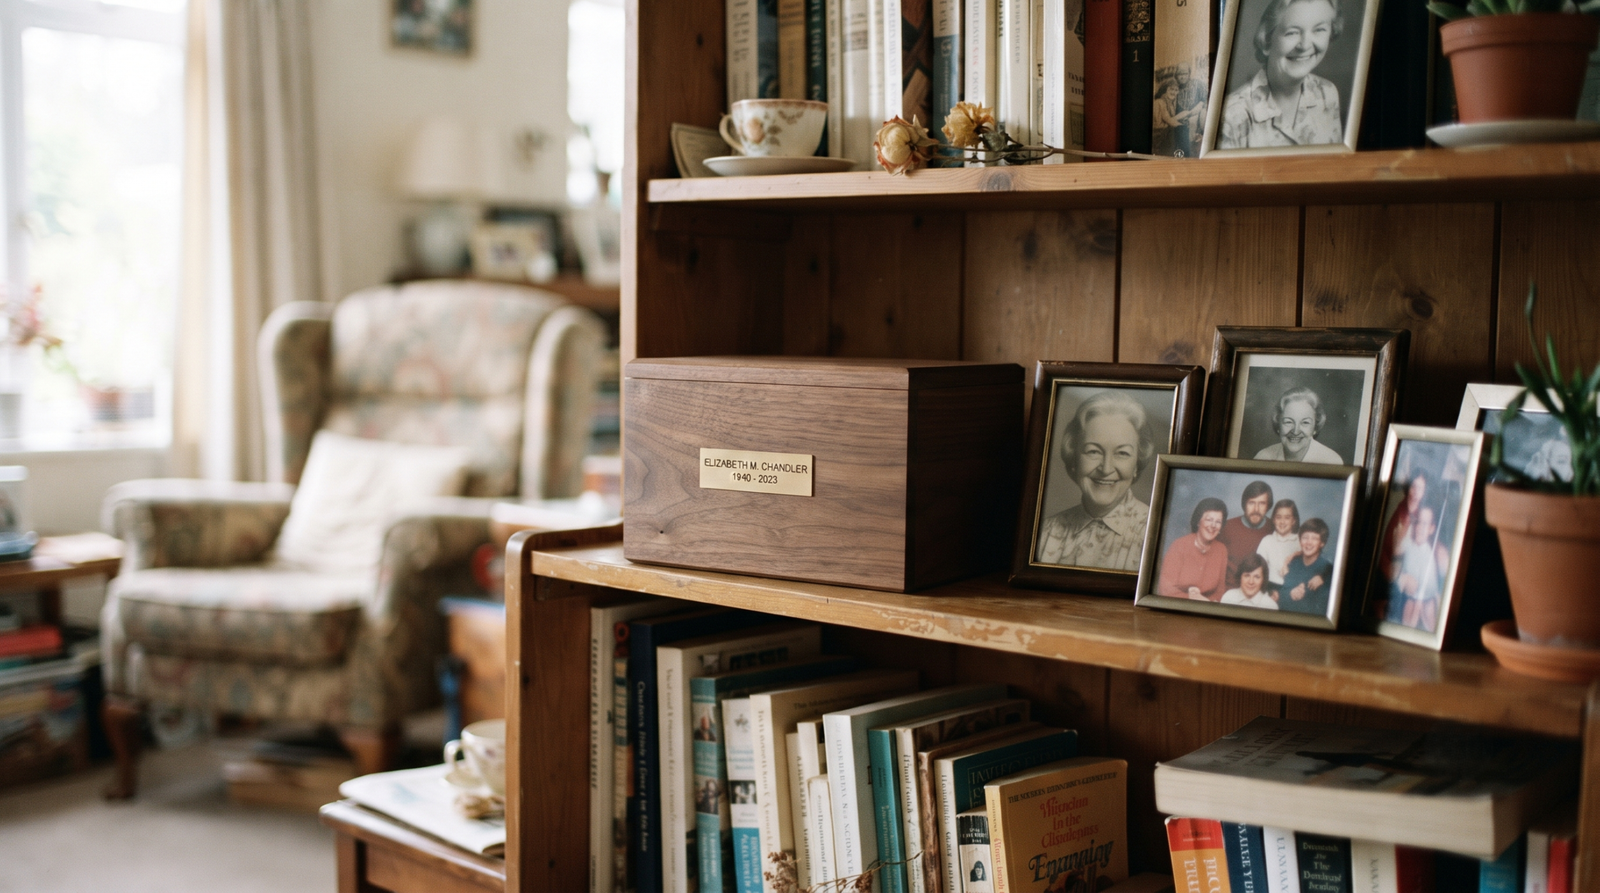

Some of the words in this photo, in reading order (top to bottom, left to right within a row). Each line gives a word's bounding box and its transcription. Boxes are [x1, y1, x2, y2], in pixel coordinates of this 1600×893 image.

[1132, 49, 1140, 63] 1
[704, 458, 748, 469] ELIZABETH
[749, 461, 759, 471] M.
[761, 462, 808, 474] CHANDLER
[732, 472, 751, 482] 1940
[758, 474, 778, 484] 2023
[1065, 813, 1081, 828] the
